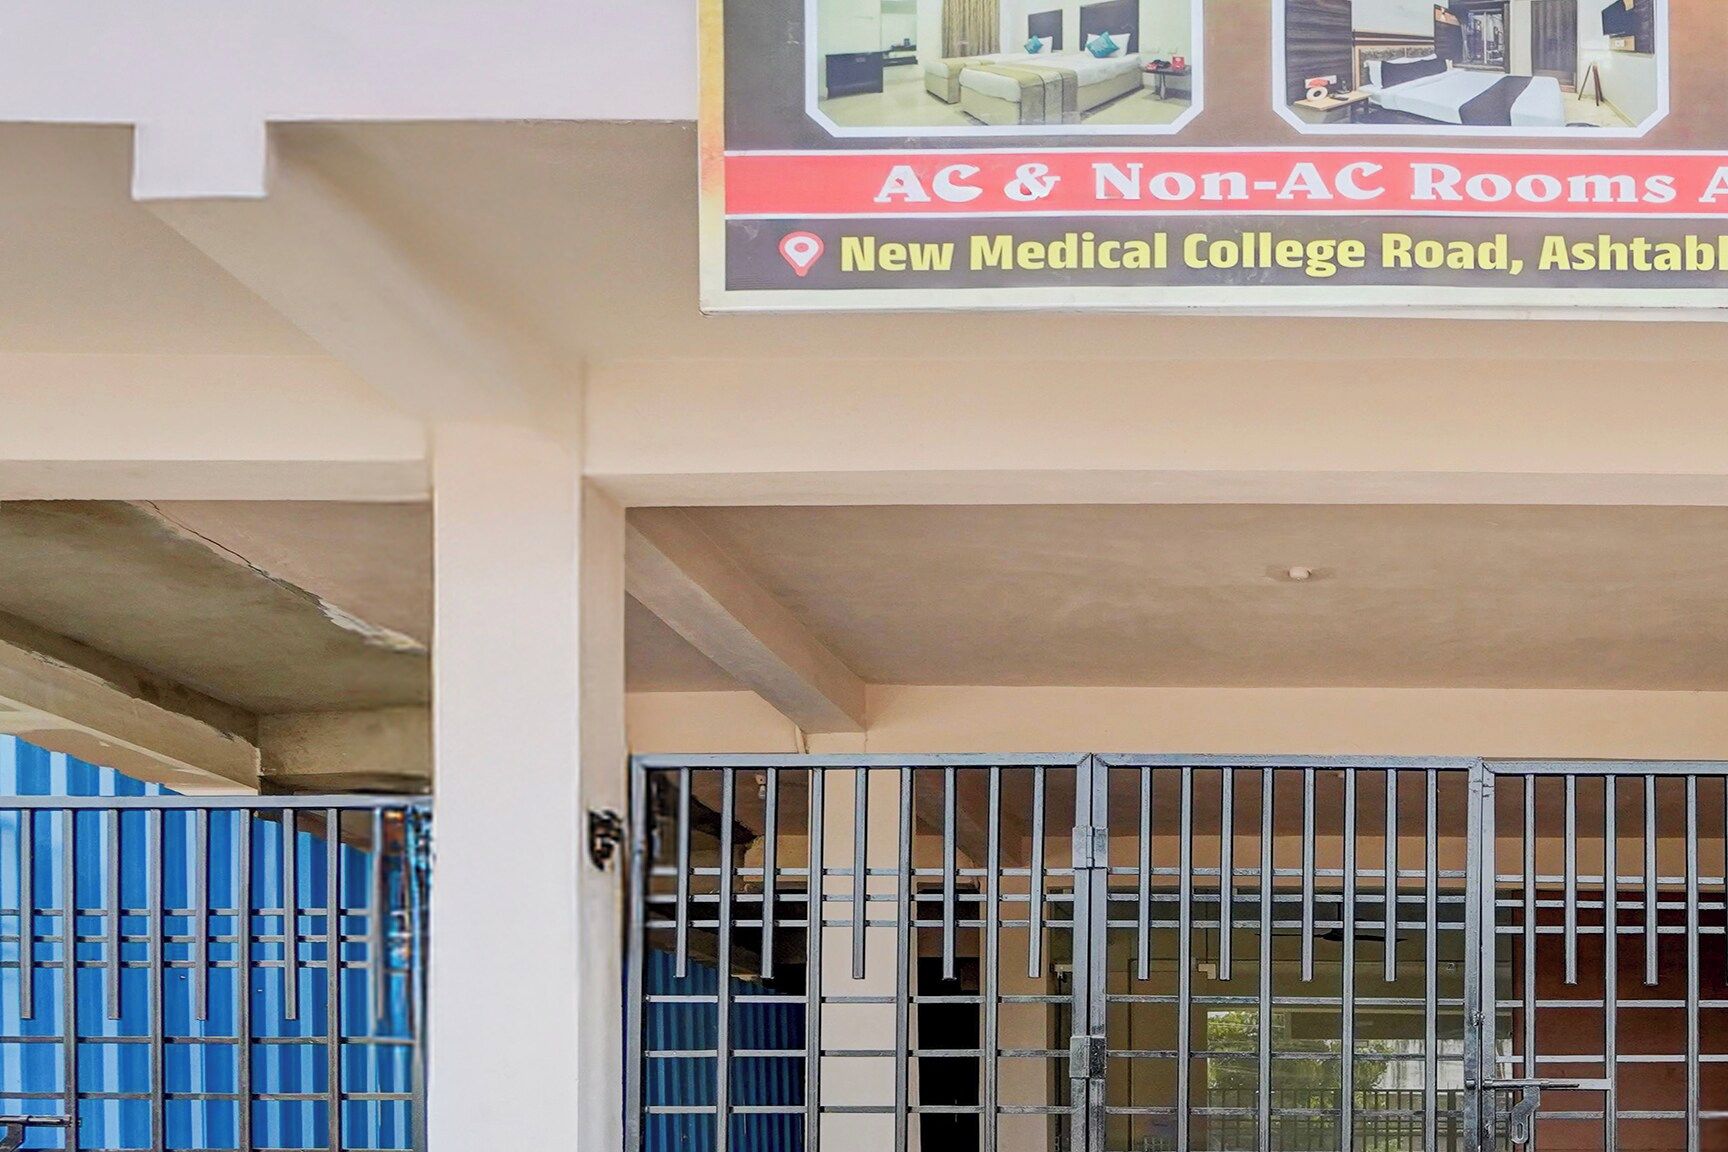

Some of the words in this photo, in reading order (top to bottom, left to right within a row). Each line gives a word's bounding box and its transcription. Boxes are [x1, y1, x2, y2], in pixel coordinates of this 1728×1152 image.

[873, 163, 984, 203] AC
[1003, 162, 1061, 202] &
[1091, 161, 1386, 201] Non-AC
[1409, 162, 1677, 204] Rooms
[840, 236, 953, 272] New
[969, 231, 1168, 270] Medical
[1183, 231, 1366, 277] College
[1381, 231, 1524, 274] Road,
